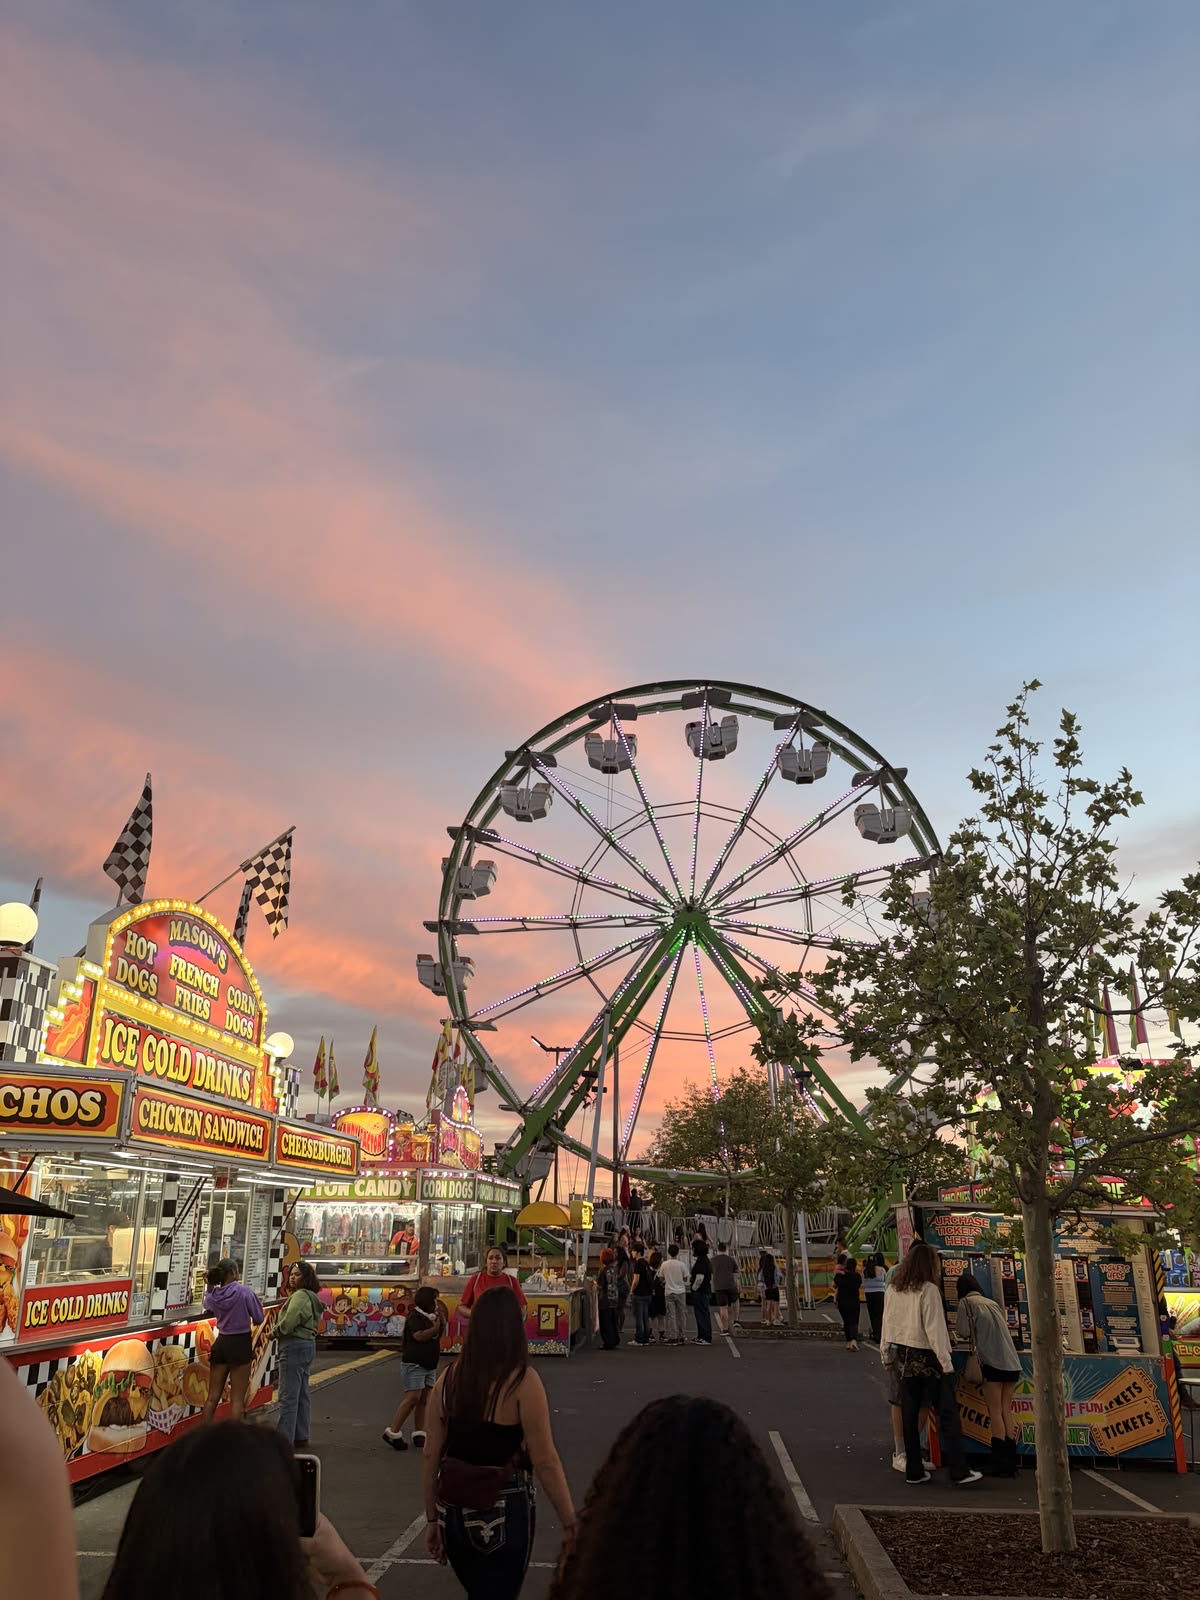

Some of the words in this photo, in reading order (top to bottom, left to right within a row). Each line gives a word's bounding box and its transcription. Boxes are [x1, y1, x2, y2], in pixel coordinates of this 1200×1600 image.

[125, 930, 157, 965] HOT
[170, 920, 227, 970] MASON'S
[116, 957, 158, 996] DOGS
[169, 954, 219, 997] FRENCH
[174, 985, 210, 1020] FRIES
[227, 985, 255, 1016] CORN
[225, 1010, 253, 1039] DOGS
[101, 1018, 140, 1068] ICE
[142, 1034, 191, 1083] COLD
[193, 1051, 250, 1101] DRINKS
[0, 1085, 102, 1122] CHOS
[139, 1098, 203, 1137] CHICKEN
[204, 1113, 263, 1149] SANDWICH
[281, 1133, 351, 1166] CHEESEBURGER
[288, 1183, 349, 1196] OTTON
[354, 1180, 413, 1196] CANDY
[423, 1181, 447, 1198] CORN
[448, 1180, 473, 1199] DOGS
[936, 1226, 981, 1236] TICKETS
[945, 1236, 974, 1246] HERE
[25, 1300, 49, 1327] ICE
[51, 1296, 84, 1323] COLD
[85, 1291, 128, 1318] DRINKS
[1079, 1403, 1104, 1414] FUN
[1104, 1381, 1143, 1411] CKETS
[957, 1403, 991, 1429] TICKE
[1102, 1411, 1154, 1440] TICKETS
